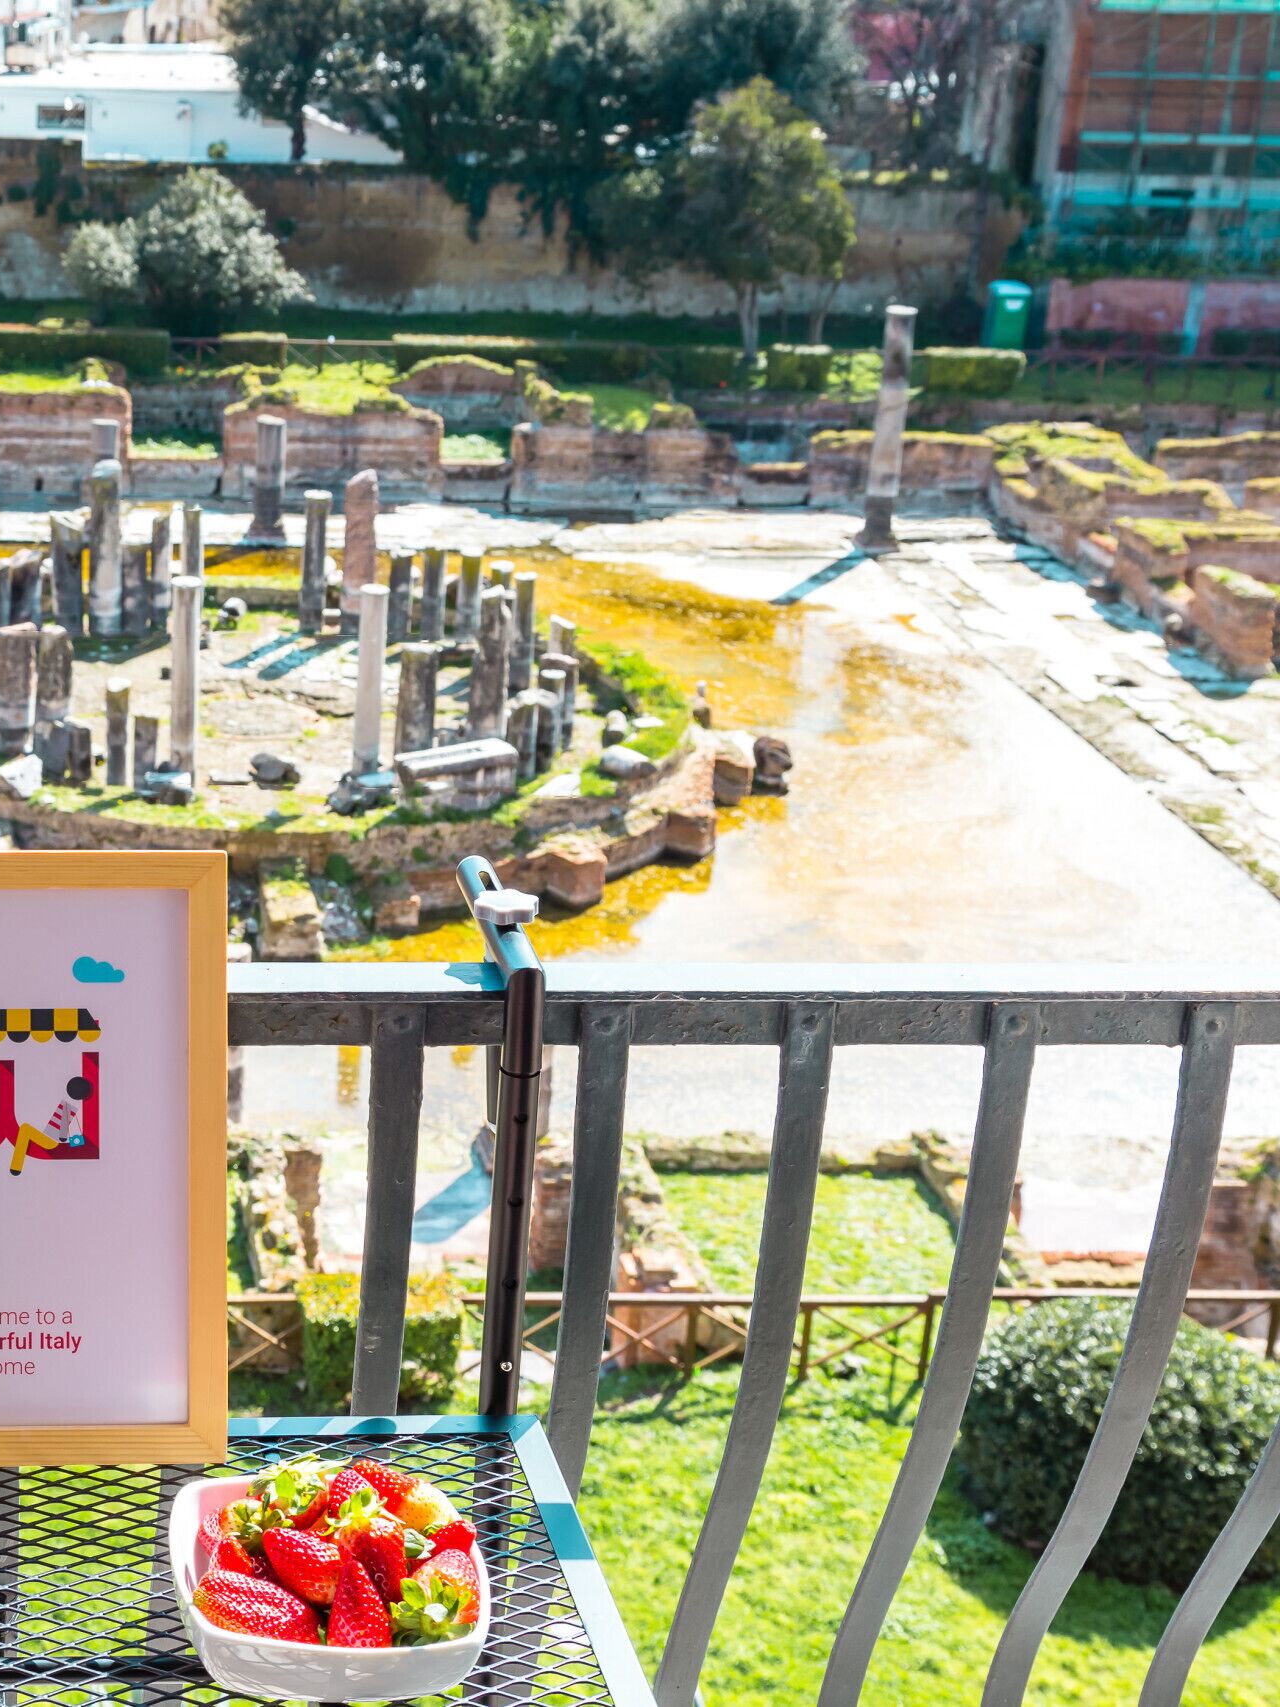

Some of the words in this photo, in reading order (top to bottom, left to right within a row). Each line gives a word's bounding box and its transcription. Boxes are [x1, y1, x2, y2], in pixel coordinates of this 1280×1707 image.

[36, 1308, 56, 1325] to
[61, 1311, 73, 1325] a
[40, 1331, 82, 1354] Italy
